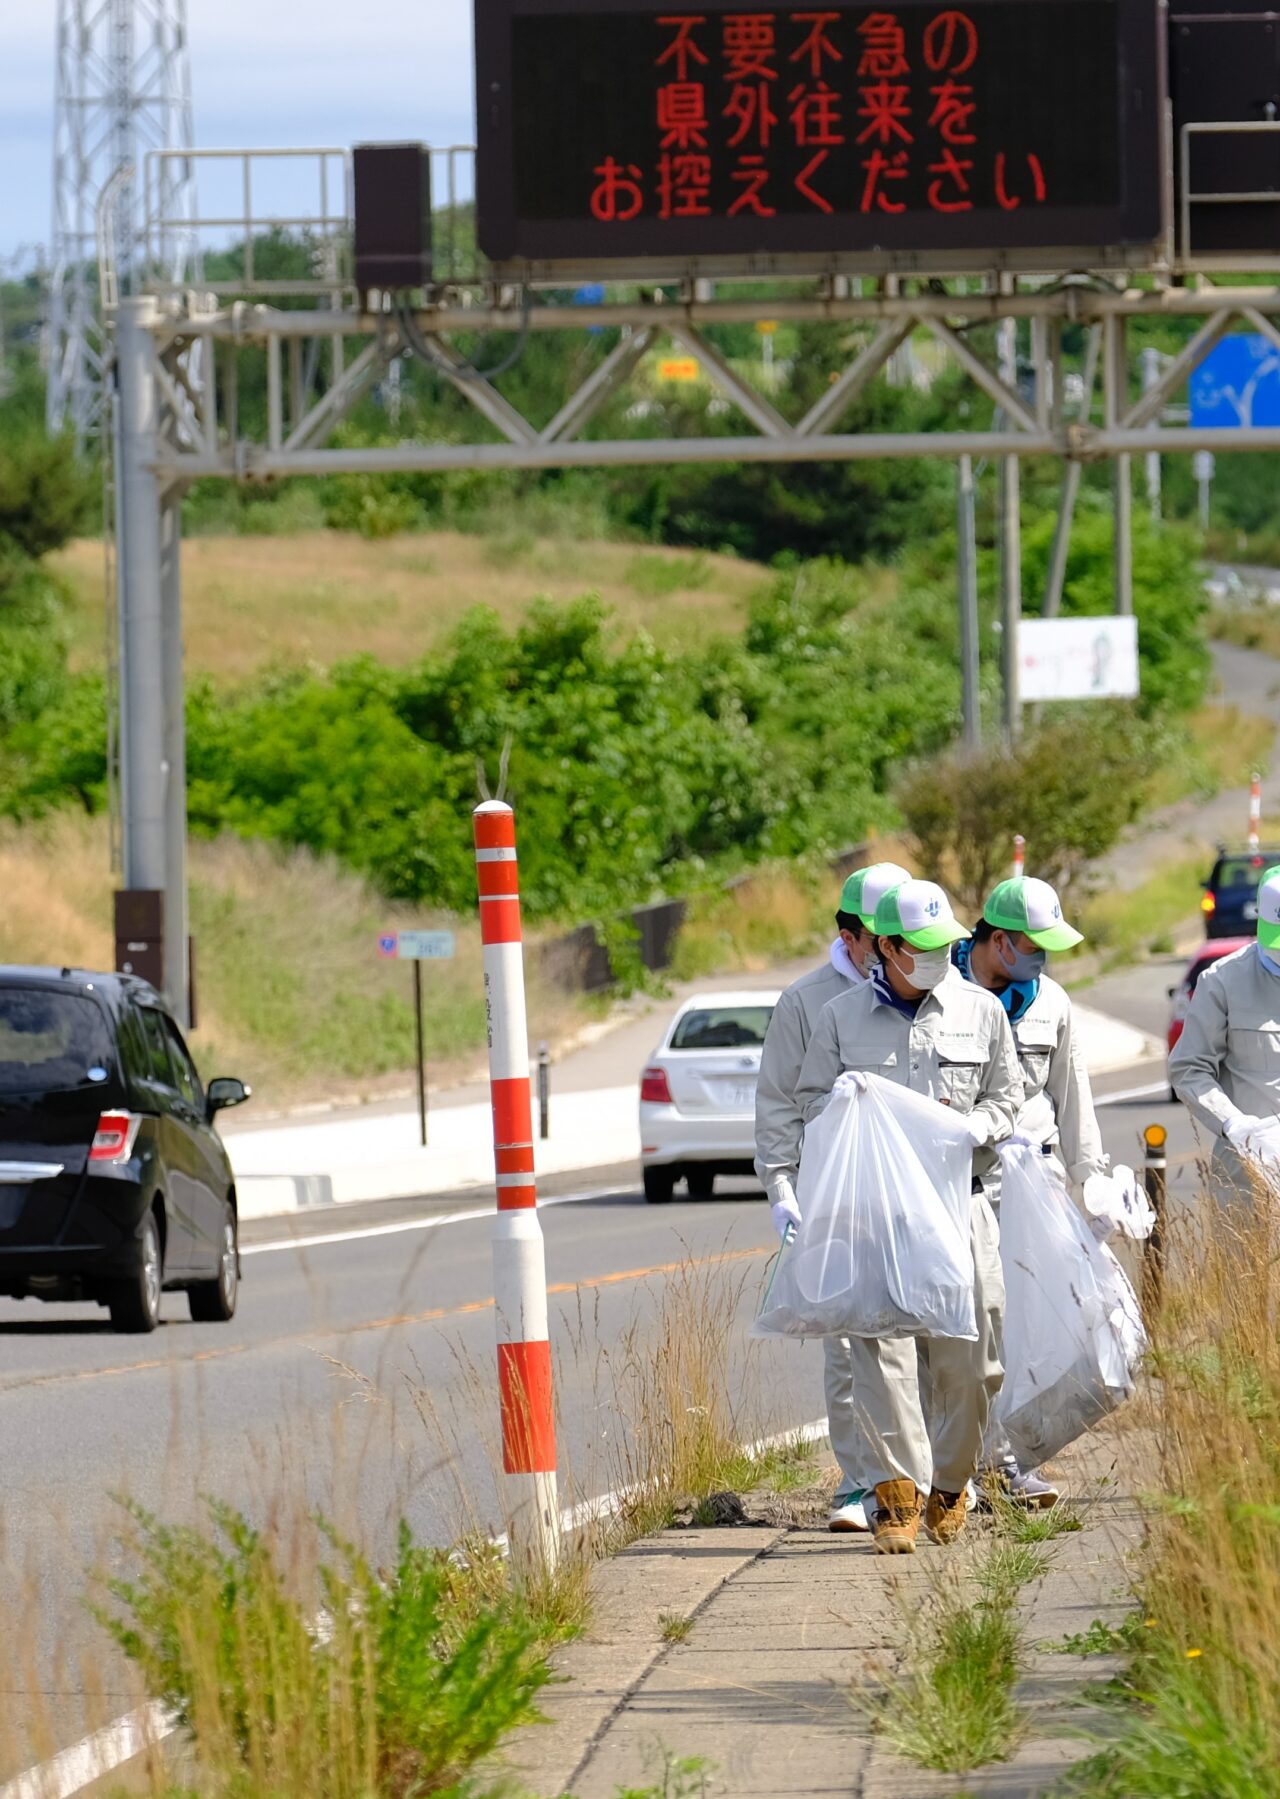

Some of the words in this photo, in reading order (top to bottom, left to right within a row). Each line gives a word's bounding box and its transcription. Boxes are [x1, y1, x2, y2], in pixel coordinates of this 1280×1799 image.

[654, 11, 979, 80] 不要不急の
[655, 81, 977, 148] 県外往来を
[589, 149, 1047, 221] お控えください
